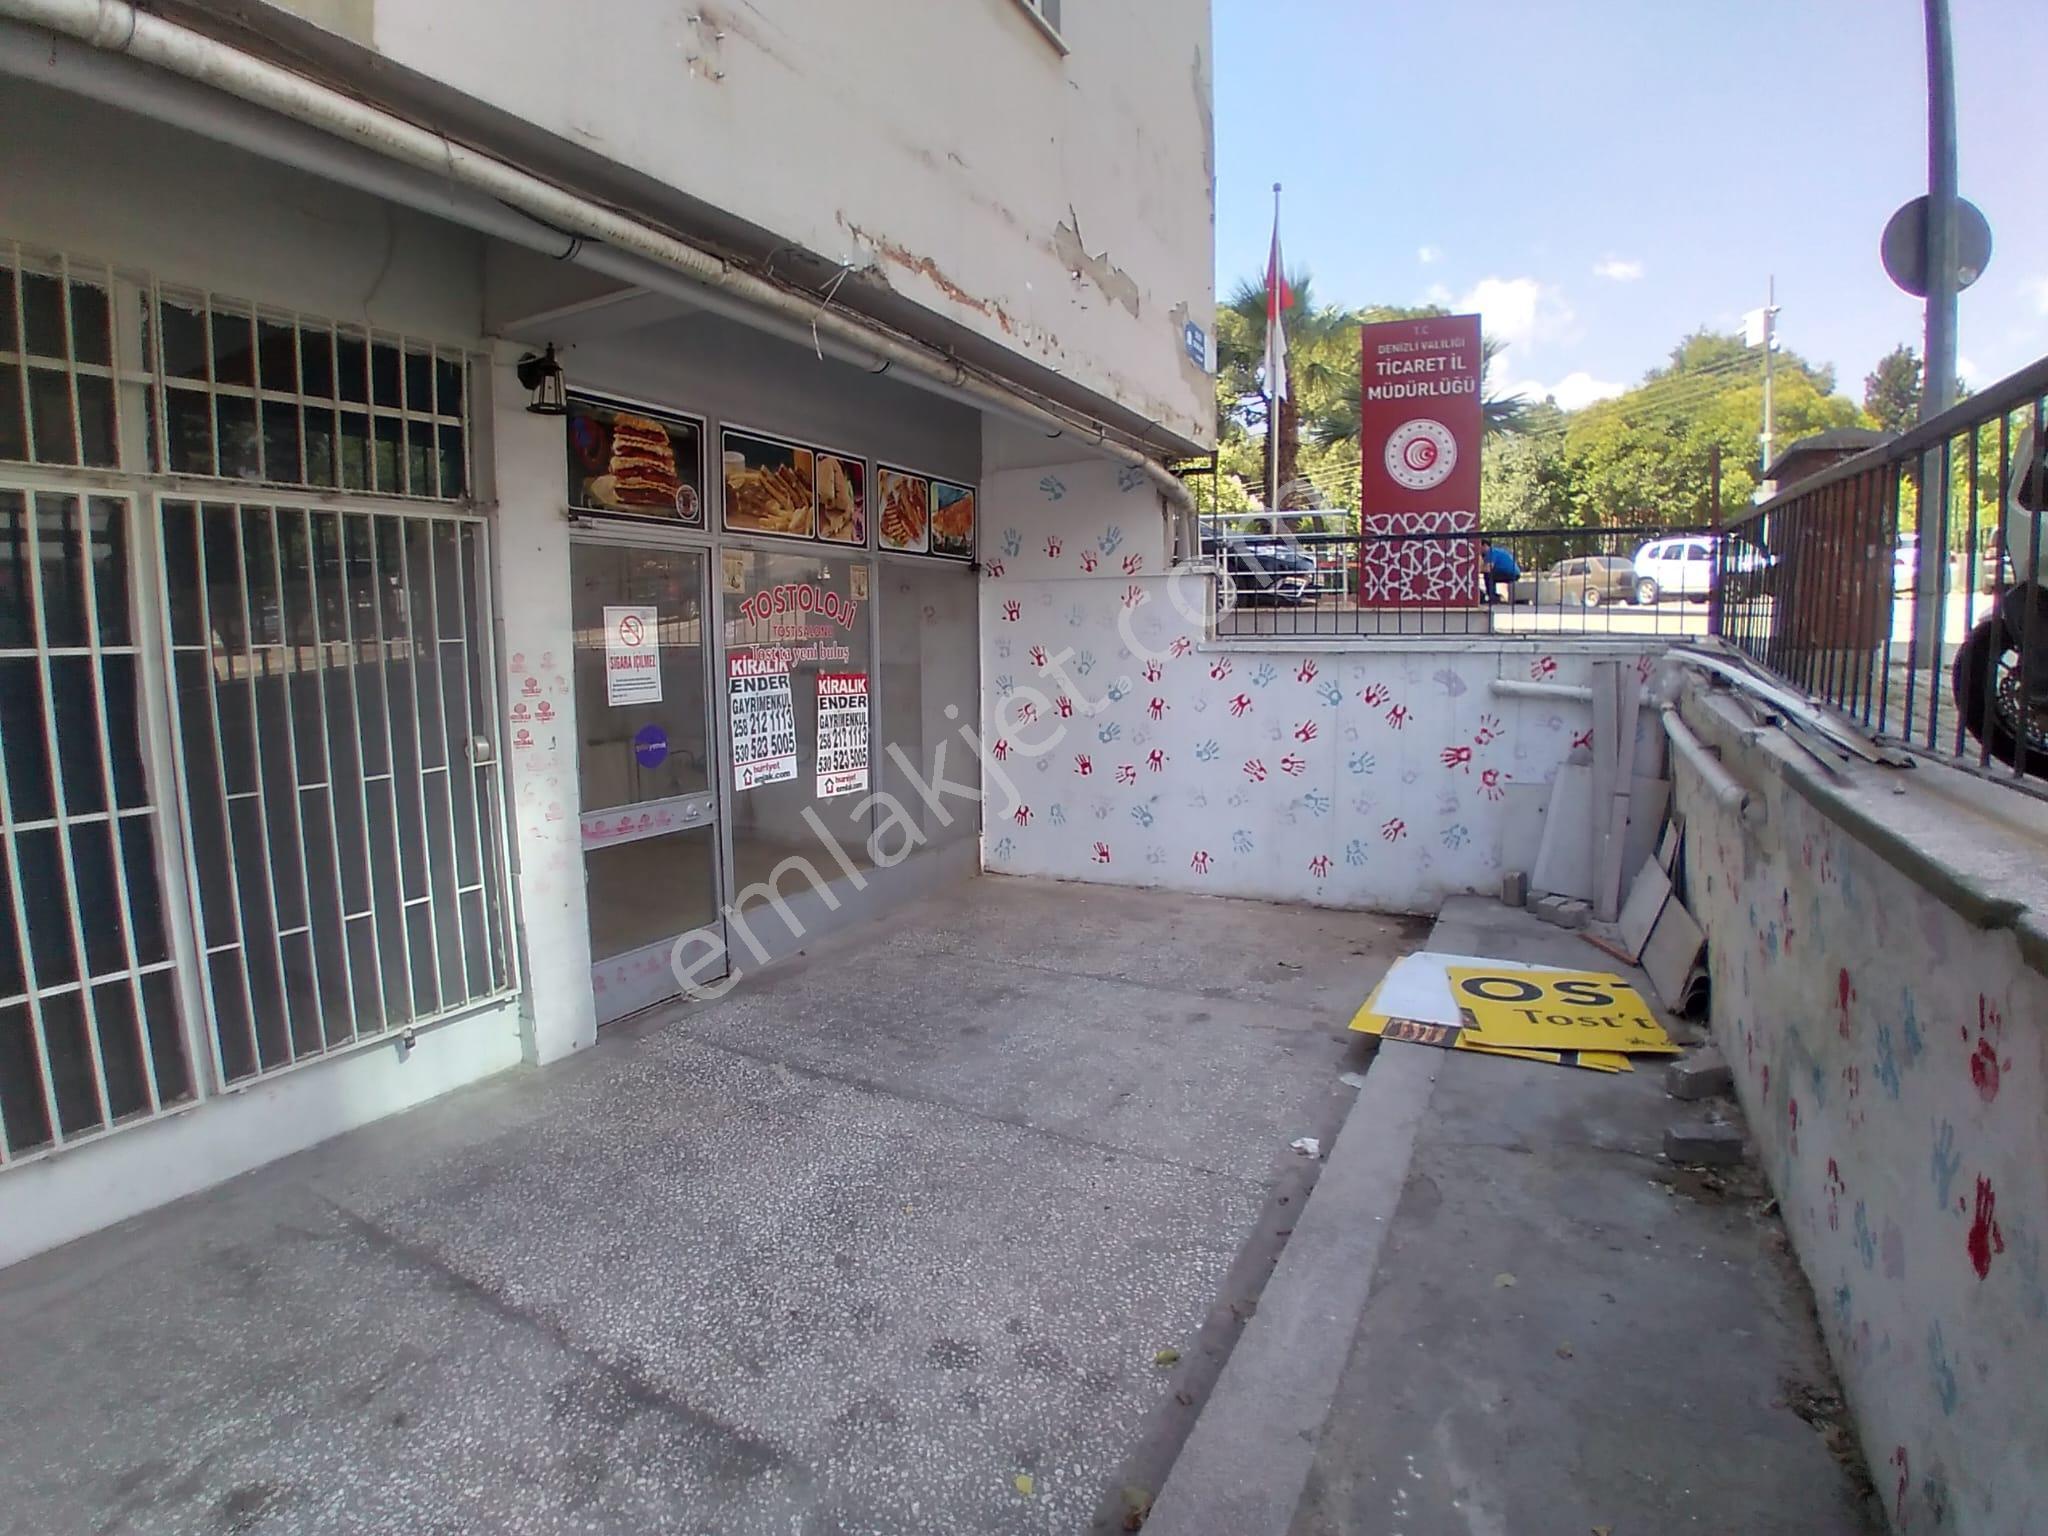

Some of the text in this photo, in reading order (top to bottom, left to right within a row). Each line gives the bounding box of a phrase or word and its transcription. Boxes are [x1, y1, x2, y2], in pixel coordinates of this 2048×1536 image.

[1376, 352, 1467, 376] TİCARET İL
[1367, 375, 1476, 401] MÜDÜRLÜĞÜ
[773, 625, 795, 637] TOST
[731, 655, 789, 676] KİRALIK
[792, 642, 817, 667] yeni
[819, 641, 849, 663] buluş
[730, 676, 789, 693] ENDER
[818, 676, 867, 694] KİRALIK
[732, 693, 791, 715] GAYRİMENKUL
[819, 695, 867, 710] ENDER
[733, 703, 793, 738] 258 212 1113
[819, 710, 867, 729] GAYRİMENKUL
[735, 732, 795, 763] 530 523 5005
[819, 726, 867, 750] 258 212 1113
[818, 747, 867, 773] 530 523 5005
[1461, 977, 1633, 1006] OS
